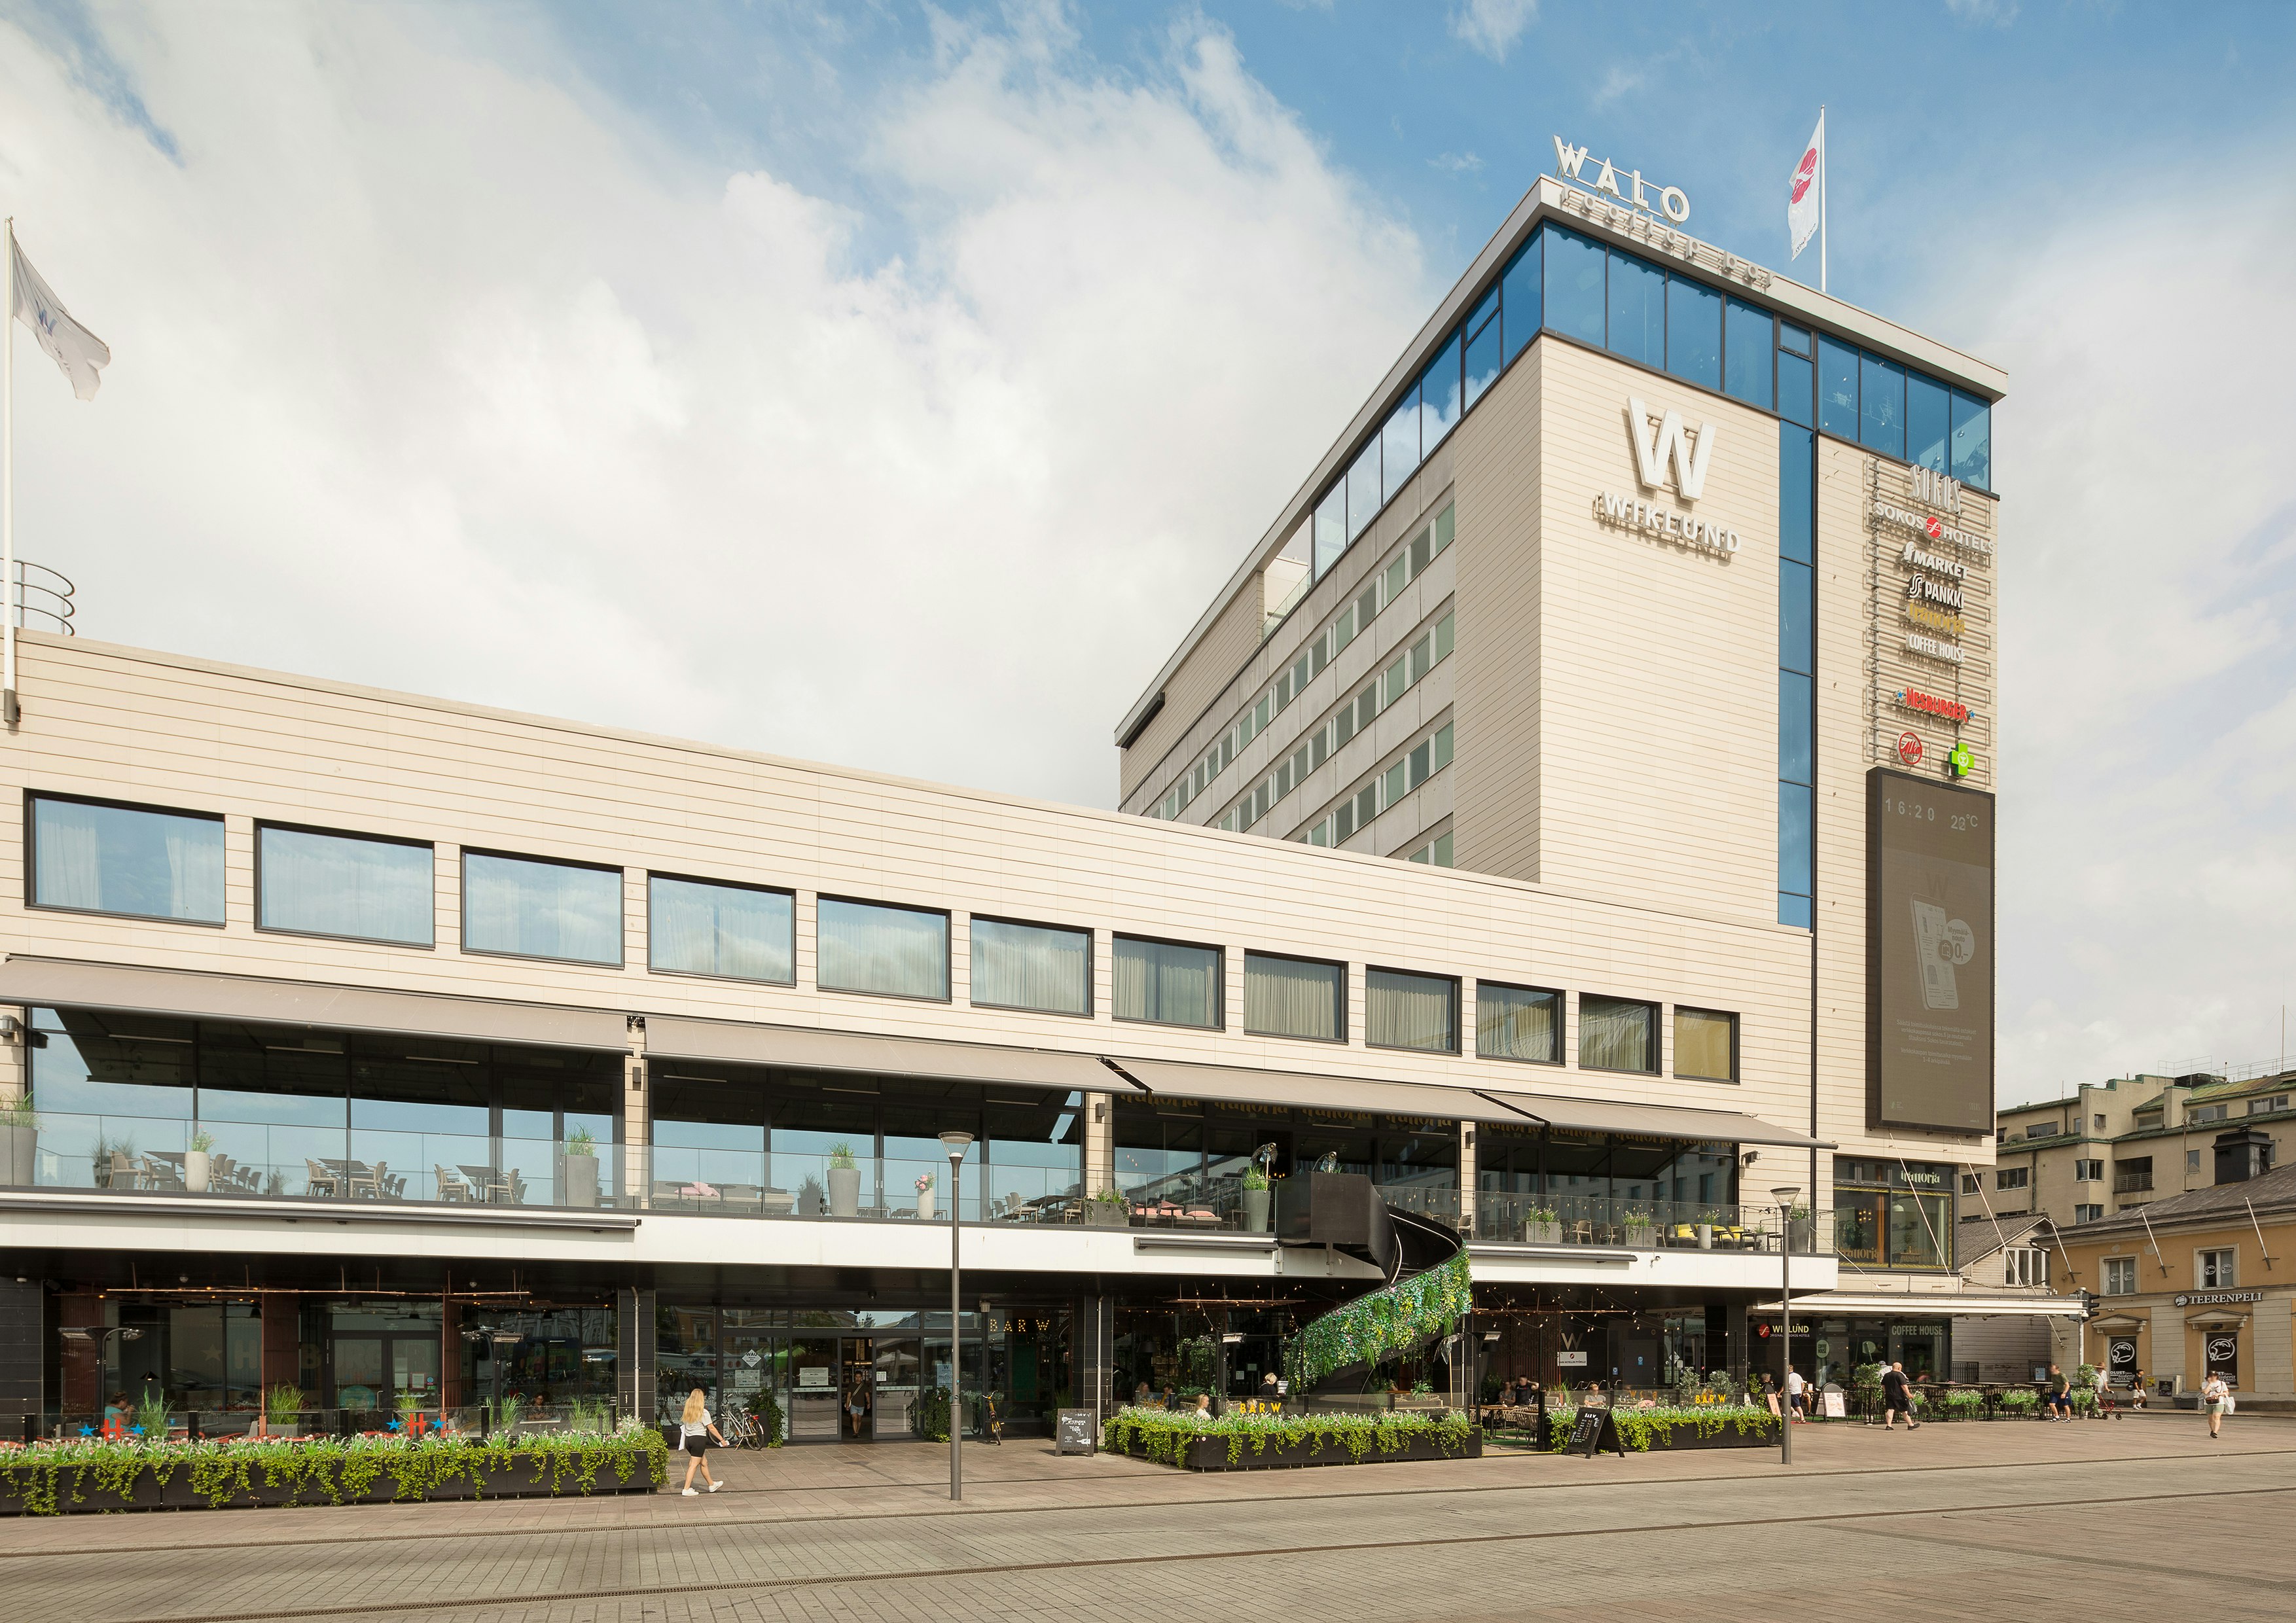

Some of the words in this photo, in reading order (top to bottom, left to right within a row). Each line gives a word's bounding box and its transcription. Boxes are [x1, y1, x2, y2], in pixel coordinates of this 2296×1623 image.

[1552, 135, 1690, 224] WALO
[1560, 186, 1701, 260] rooftop
[1721, 251, 1776, 288] bar
[1626, 395, 1717, 502] W
[1602, 491, 1742, 553] WIKLUND
[1873, 501, 1924, 531] SOKOS
[1943, 526, 1995, 555] HOTELS
[1913, 549, 1969, 580] MARKET
[1925, 580, 1964, 609] PANKKI
[1908, 633, 1937, 655] COFFEE
[1939, 642, 1965, 663] HOUSE
[1906, 687, 1968, 723] HESBURGER
[1900, 741, 1922, 755] Alko
[1885, 798, 1935, 821] 16:20
[2189, 1292, 2263, 1304] TEERENPELI
[990, 1319, 1026, 1332] BAR
[1036, 1319, 1050, 1330] W
[1892, 1325, 1917, 1336] COFFEE
[1919, 1325, 1943, 1336] HOUSE
[1561, 1332, 1584, 1351] W
[1240, 1402, 1266, 1414] BAR
[1270, 1402, 1282, 1413] W
[1695, 1394, 1715, 1404] BAR
[1717, 1394, 1727, 1403] W
